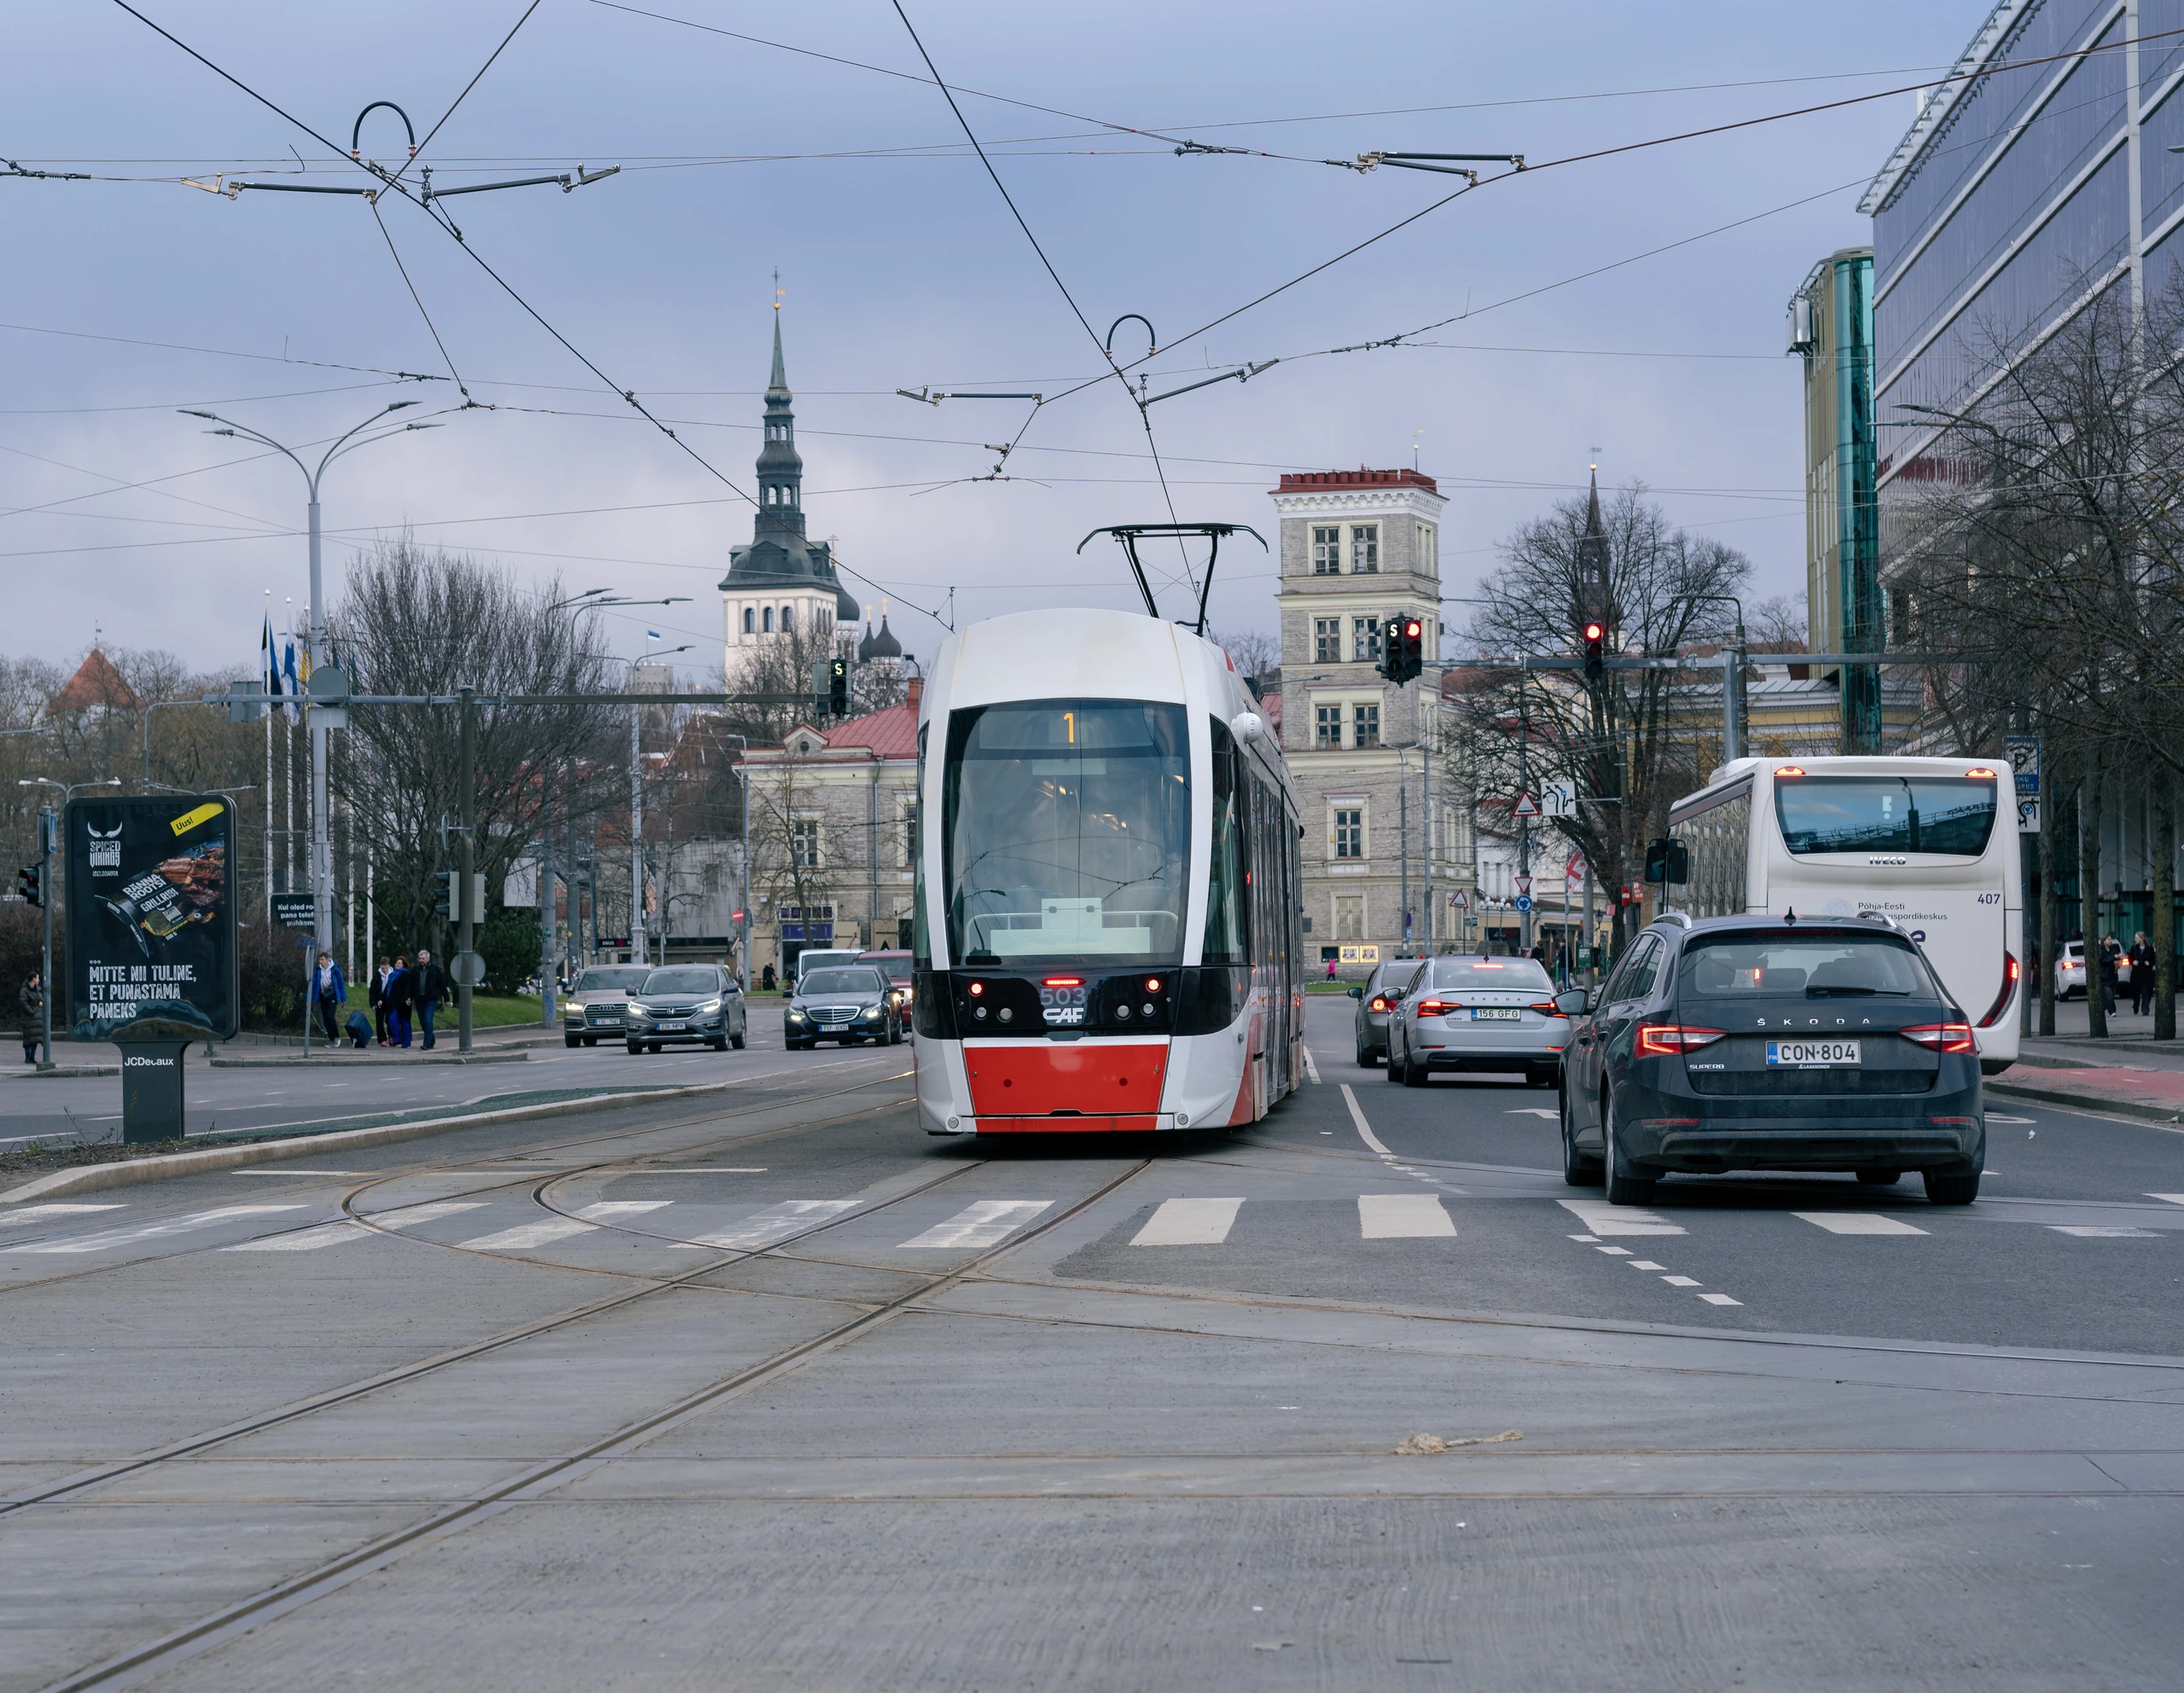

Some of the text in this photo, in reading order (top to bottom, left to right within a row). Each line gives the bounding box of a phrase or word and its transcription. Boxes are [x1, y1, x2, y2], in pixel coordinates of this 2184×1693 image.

[1063, 713, 1074, 743] 1
[176, 816, 194, 831] Uus!
[90, 841, 121, 852] SPICED
[90, 852, 120, 868] VIKINGS
[1869, 856, 1906, 865] IVECO
[140, 887, 179, 912] GRILLRIBI
[1858, 902, 1905, 911] Põhja-Eesti
[1978, 894, 2001, 904] 407
[90, 965, 197, 982] MITTE NII TULINE,
[90, 983, 181, 1000] ET PUNASTAMA
[1040, 987, 1086, 1006] 503
[90, 1002, 137, 1019] PANEKS
[1043, 1007, 1084, 1023] CAF
